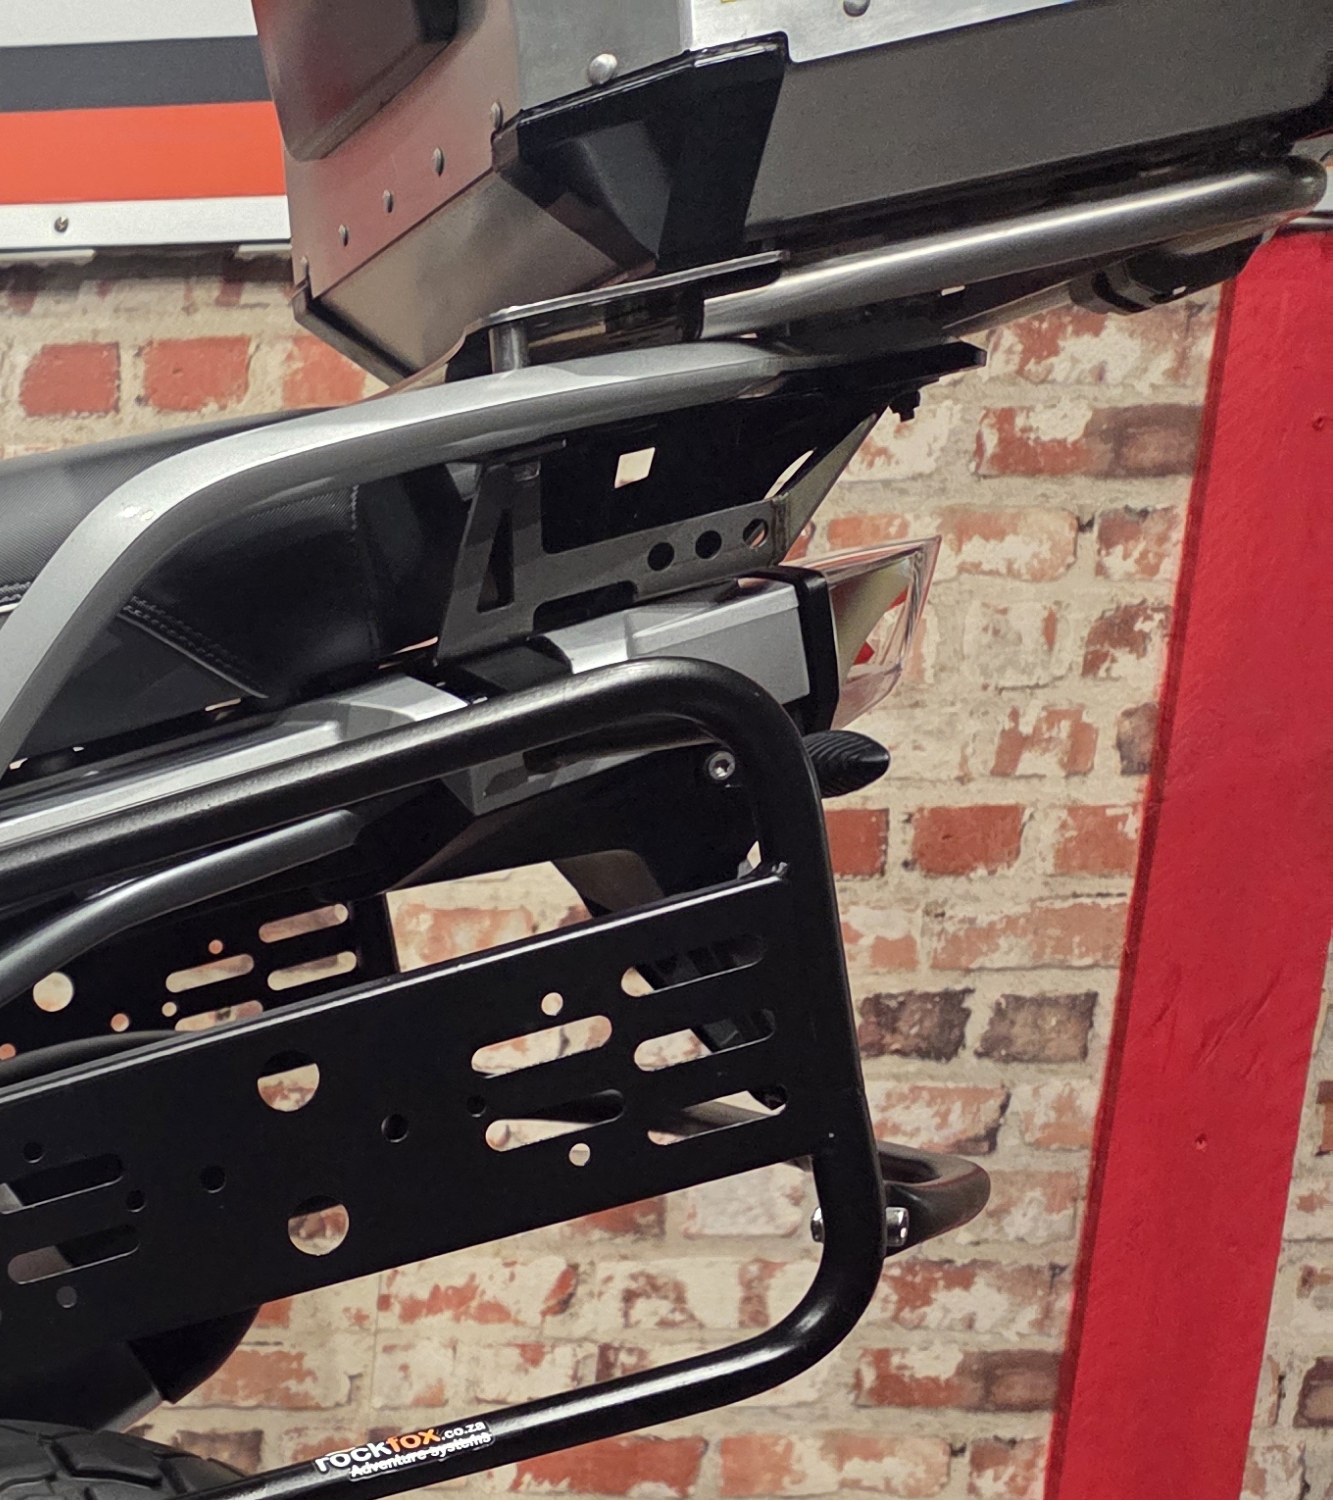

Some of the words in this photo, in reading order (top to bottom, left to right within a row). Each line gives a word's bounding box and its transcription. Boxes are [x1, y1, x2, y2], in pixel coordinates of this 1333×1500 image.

[315, 1420, 486, 1473] rockfox.co.za
[349, 1448, 427, 1478] Adventure
[431, 1431, 493, 1462] systems
